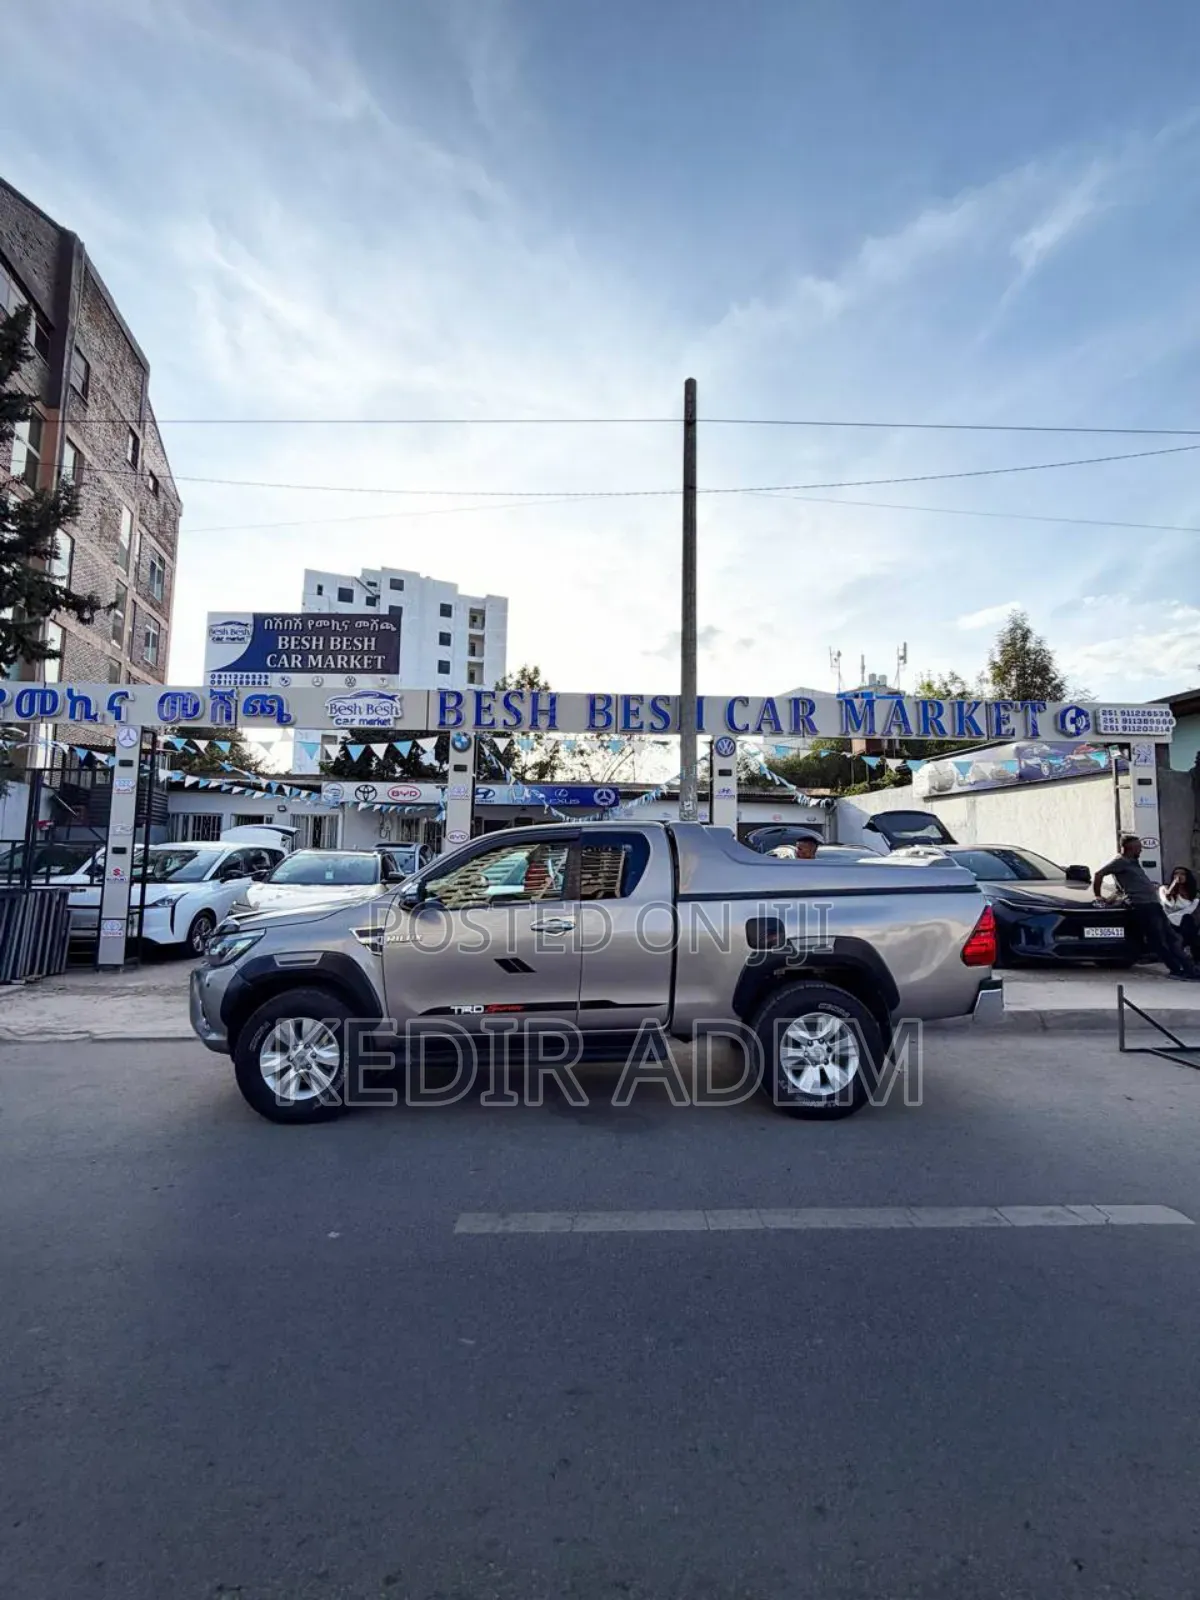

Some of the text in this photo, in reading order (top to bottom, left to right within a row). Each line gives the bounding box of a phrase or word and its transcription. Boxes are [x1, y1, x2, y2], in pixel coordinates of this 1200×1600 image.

[308, 619, 350, 631] የመኪና
[278, 635, 376, 651] BESH BESH
[266, 654, 386, 670] CAR MARKET
[329, 703, 400, 716] Besh Besh
[437, 690, 560, 730] BESH
[724, 696, 820, 736] CAR
[840, 697, 1047, 739] MARKET
[334, 717, 391, 726] car market
[450, 1004, 485, 1014] TRD
